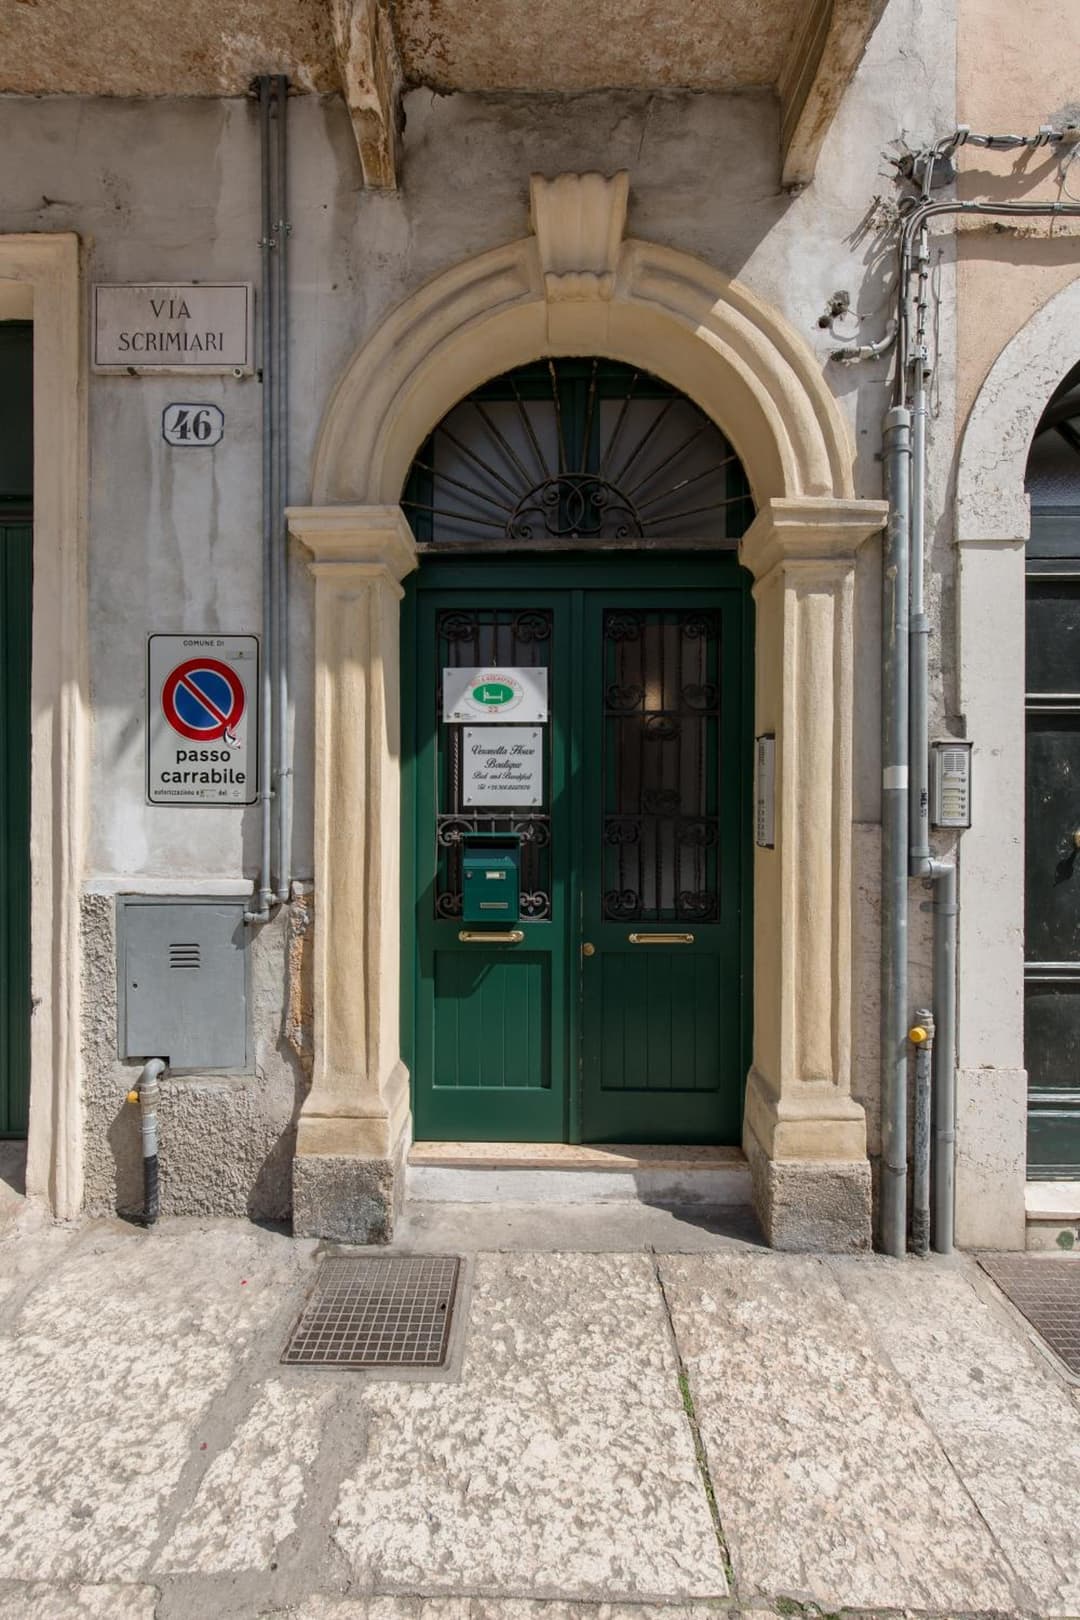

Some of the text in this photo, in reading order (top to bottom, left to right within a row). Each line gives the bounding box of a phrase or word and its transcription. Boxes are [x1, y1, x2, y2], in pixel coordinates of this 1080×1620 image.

[149, 299, 192, 320] VIA
[117, 332, 224, 352] SCRIMIARI
[170, 410, 212, 441] 46
[183, 639, 215, 647] COMUNE
[176, 749, 231, 765] passo
[160, 768, 247, 784] carrabile
